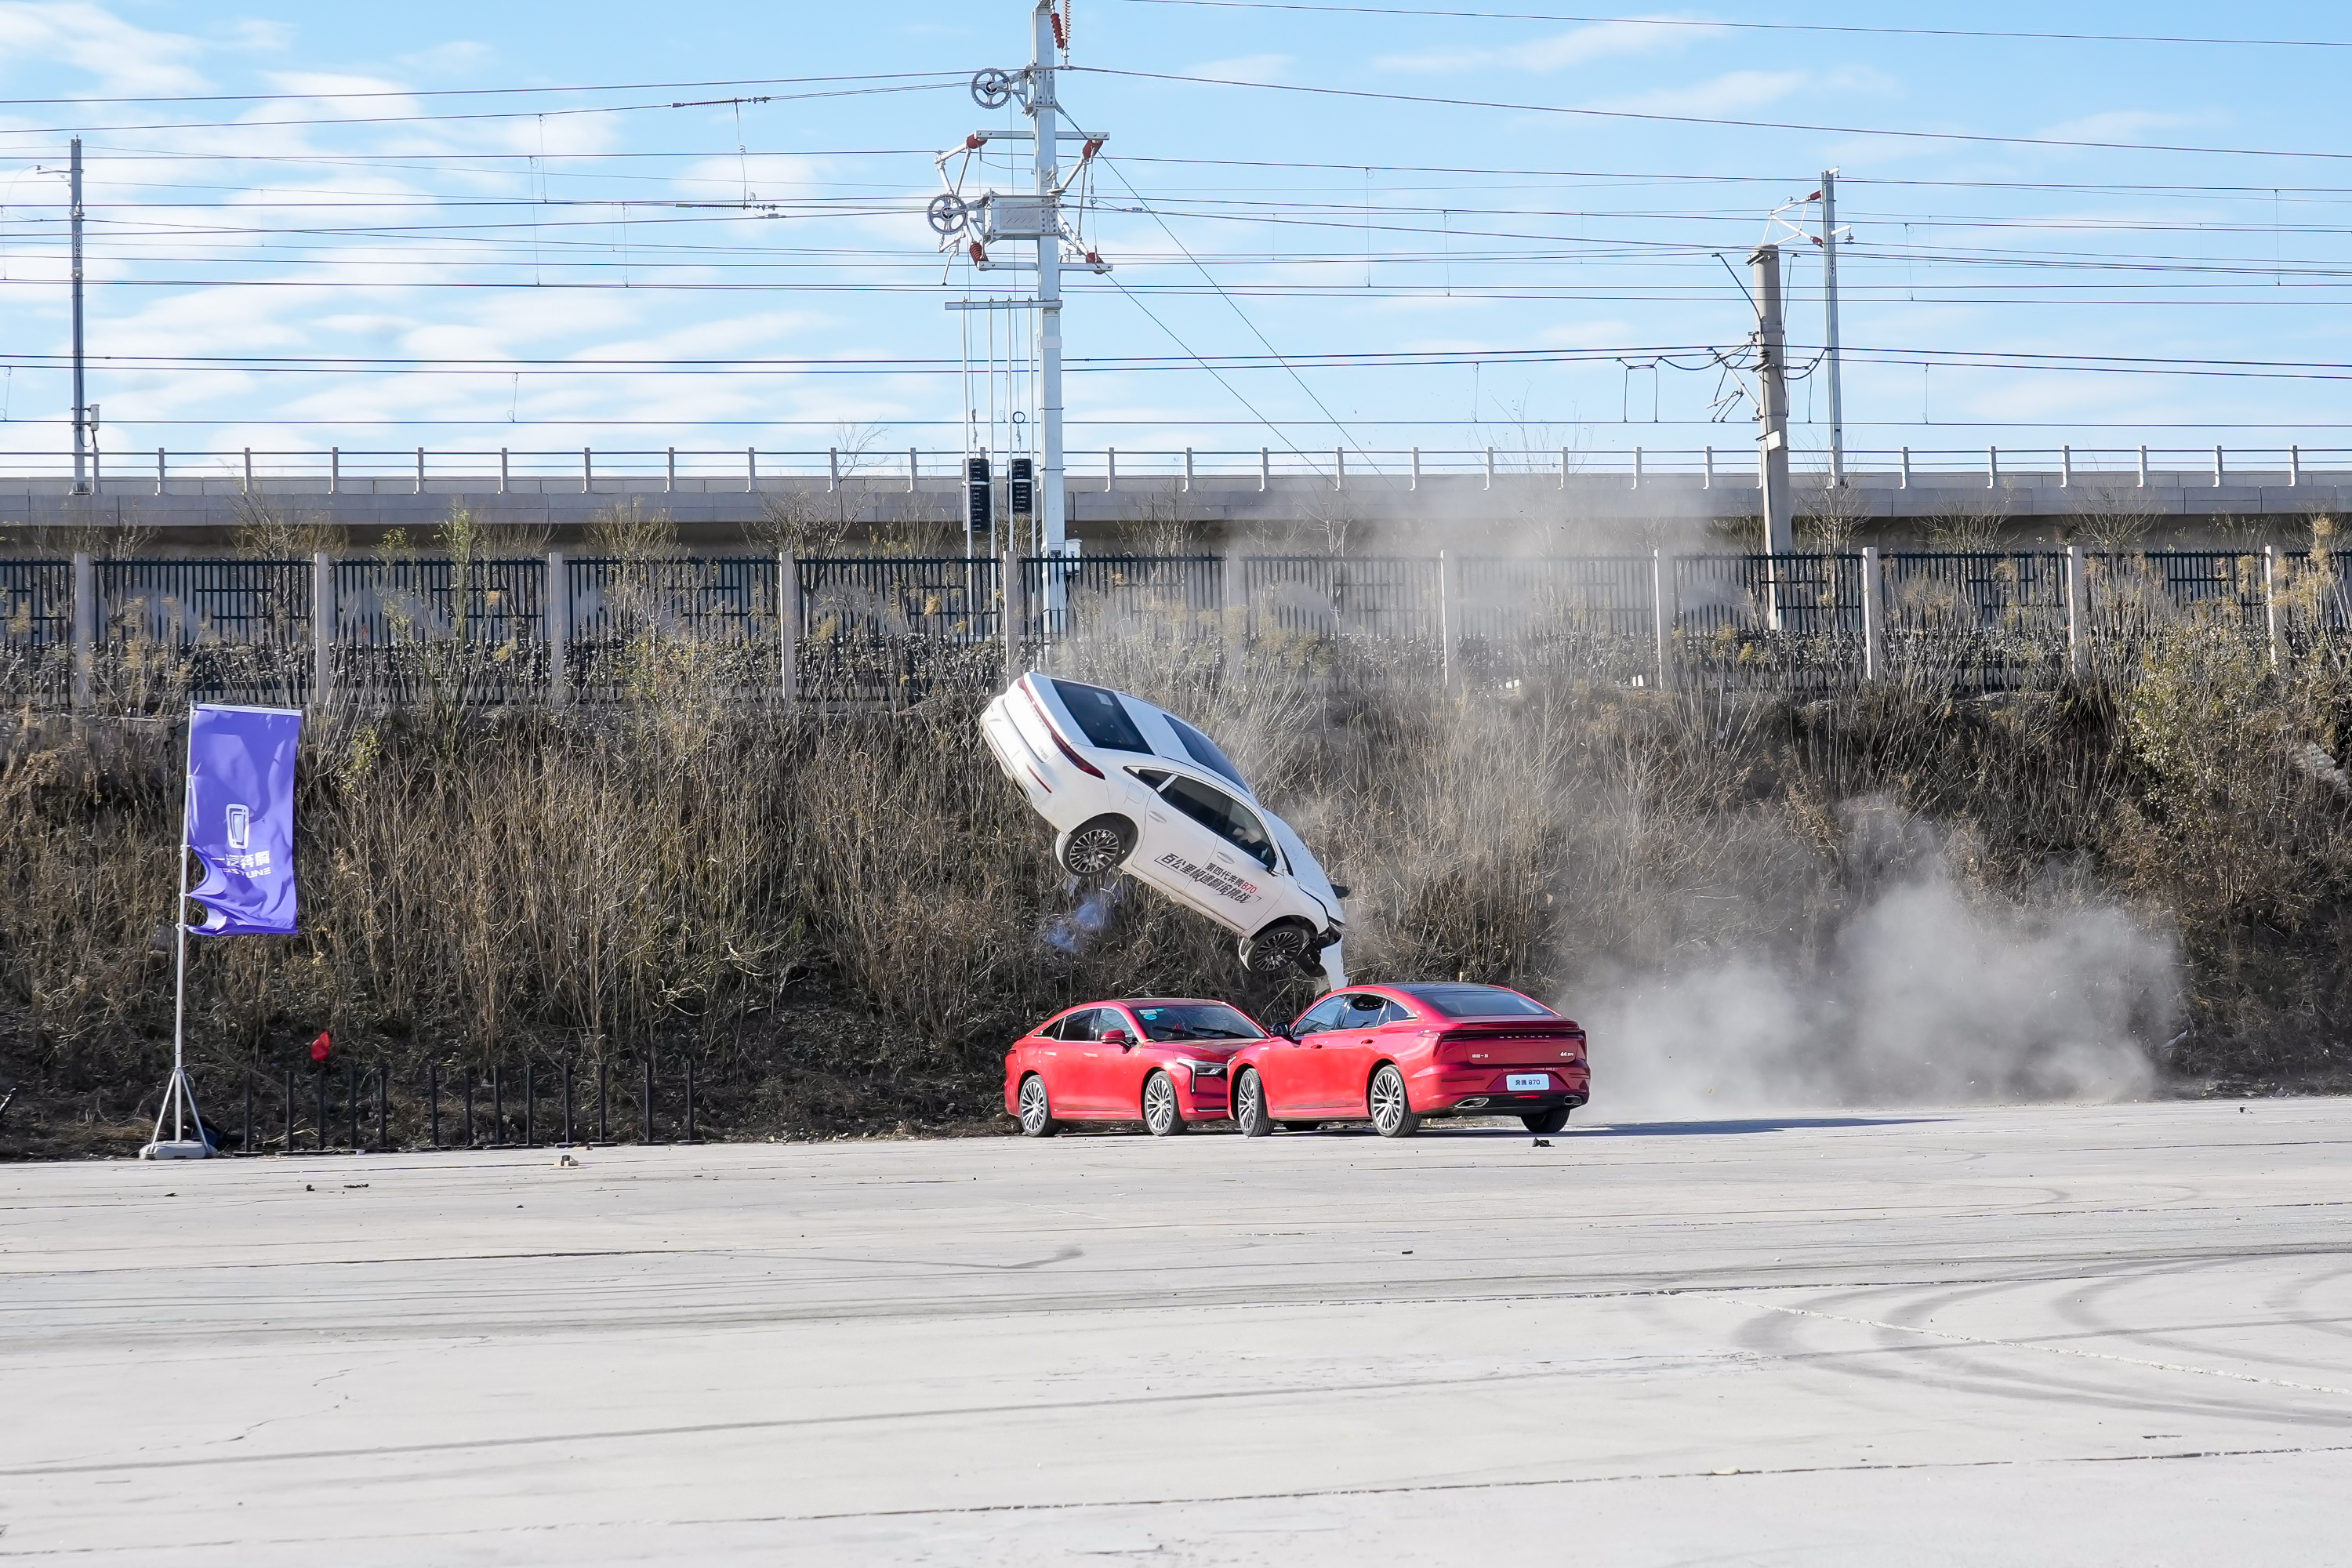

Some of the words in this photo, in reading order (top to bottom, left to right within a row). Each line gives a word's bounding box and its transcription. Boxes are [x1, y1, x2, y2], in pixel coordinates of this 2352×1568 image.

[1205, 862, 1258, 895] 第四代奔腾B70
